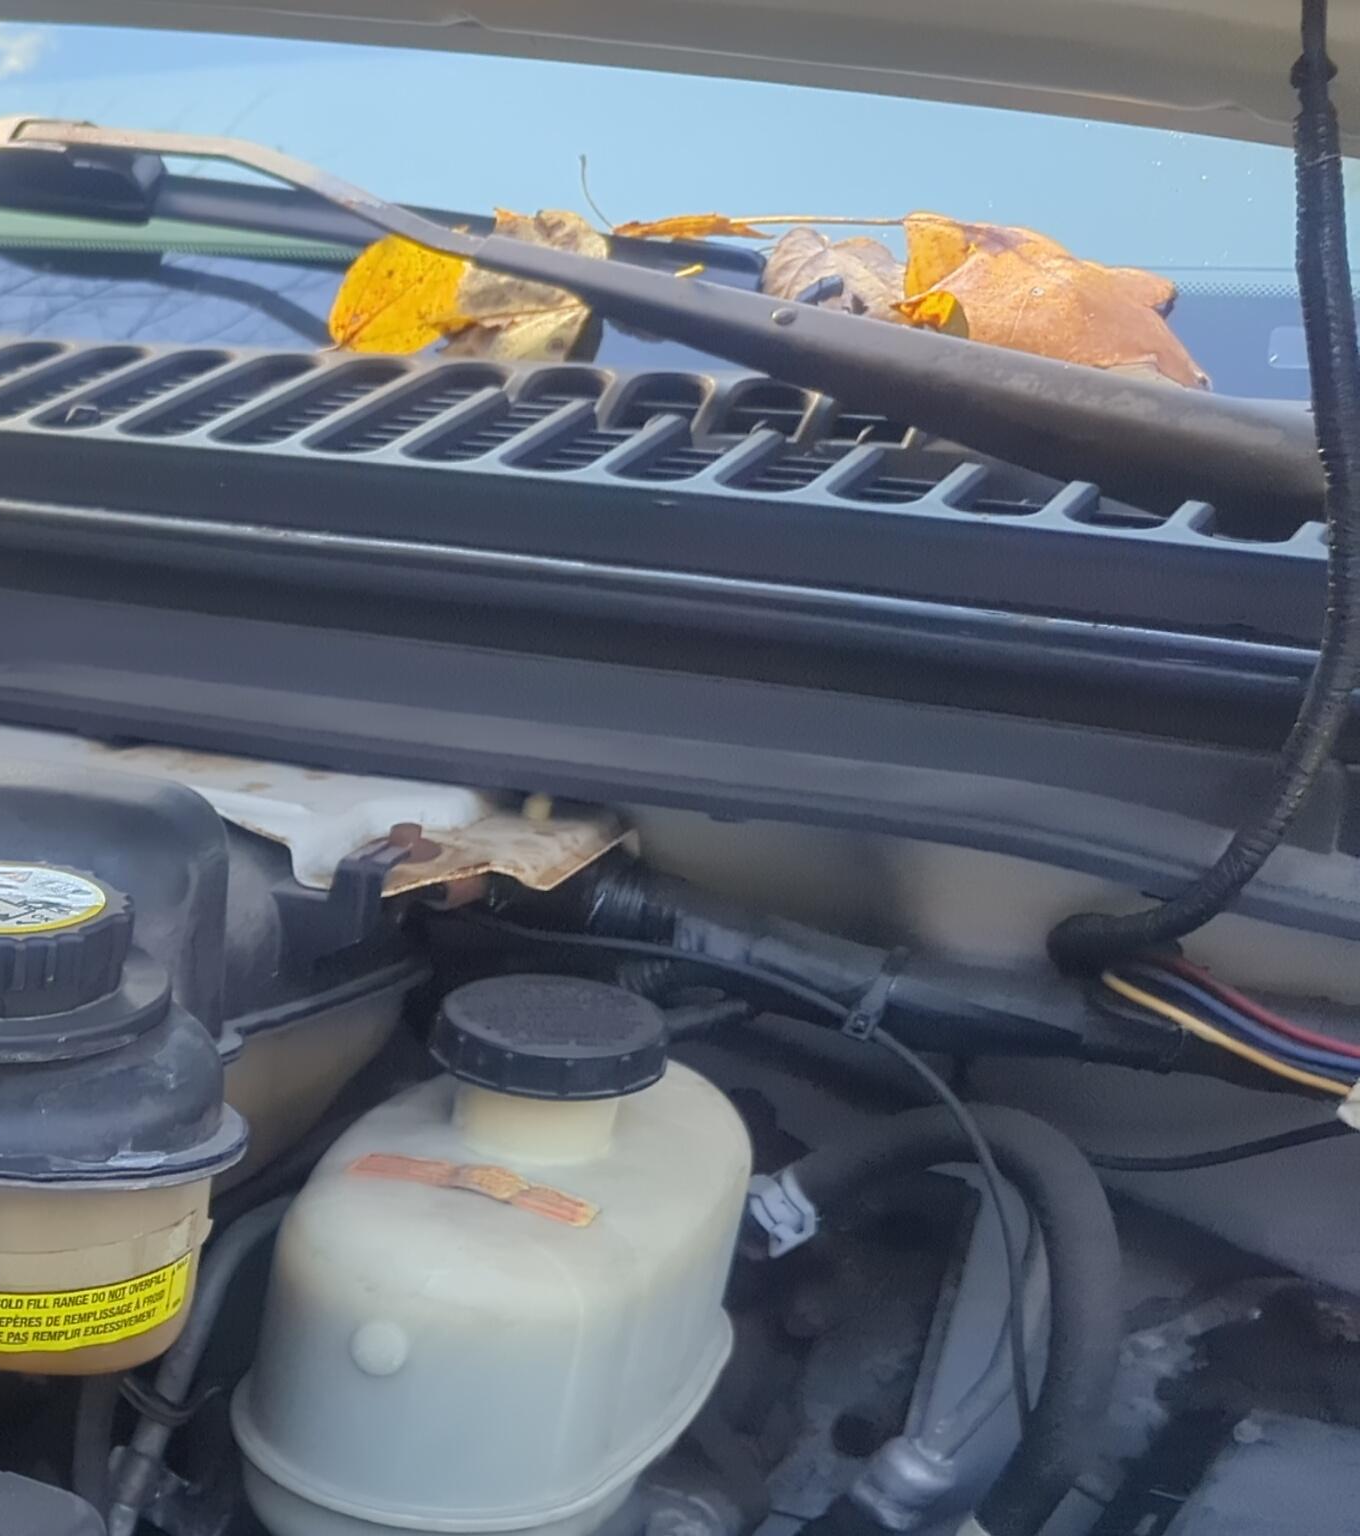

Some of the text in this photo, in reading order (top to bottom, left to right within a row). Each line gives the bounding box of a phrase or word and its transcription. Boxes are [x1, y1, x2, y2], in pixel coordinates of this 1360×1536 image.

[27, 1295, 50, 1310] FILL
[53, 1293, 88, 1309] RANGE
[91, 1292, 105, 1304] DO
[108, 1289, 126, 1303] NOT
[129, 1272, 167, 1296] OVERFILL
[7, 1332, 28, 1344] PAS
[31, 1329, 81, 1342] REMPLIR
[83, 1309, 156, 1337] EXCESSIVEMENT
[45, 1315, 61, 1326] DE
[63, 1304, 133, 1325] REMPLISSAGE
